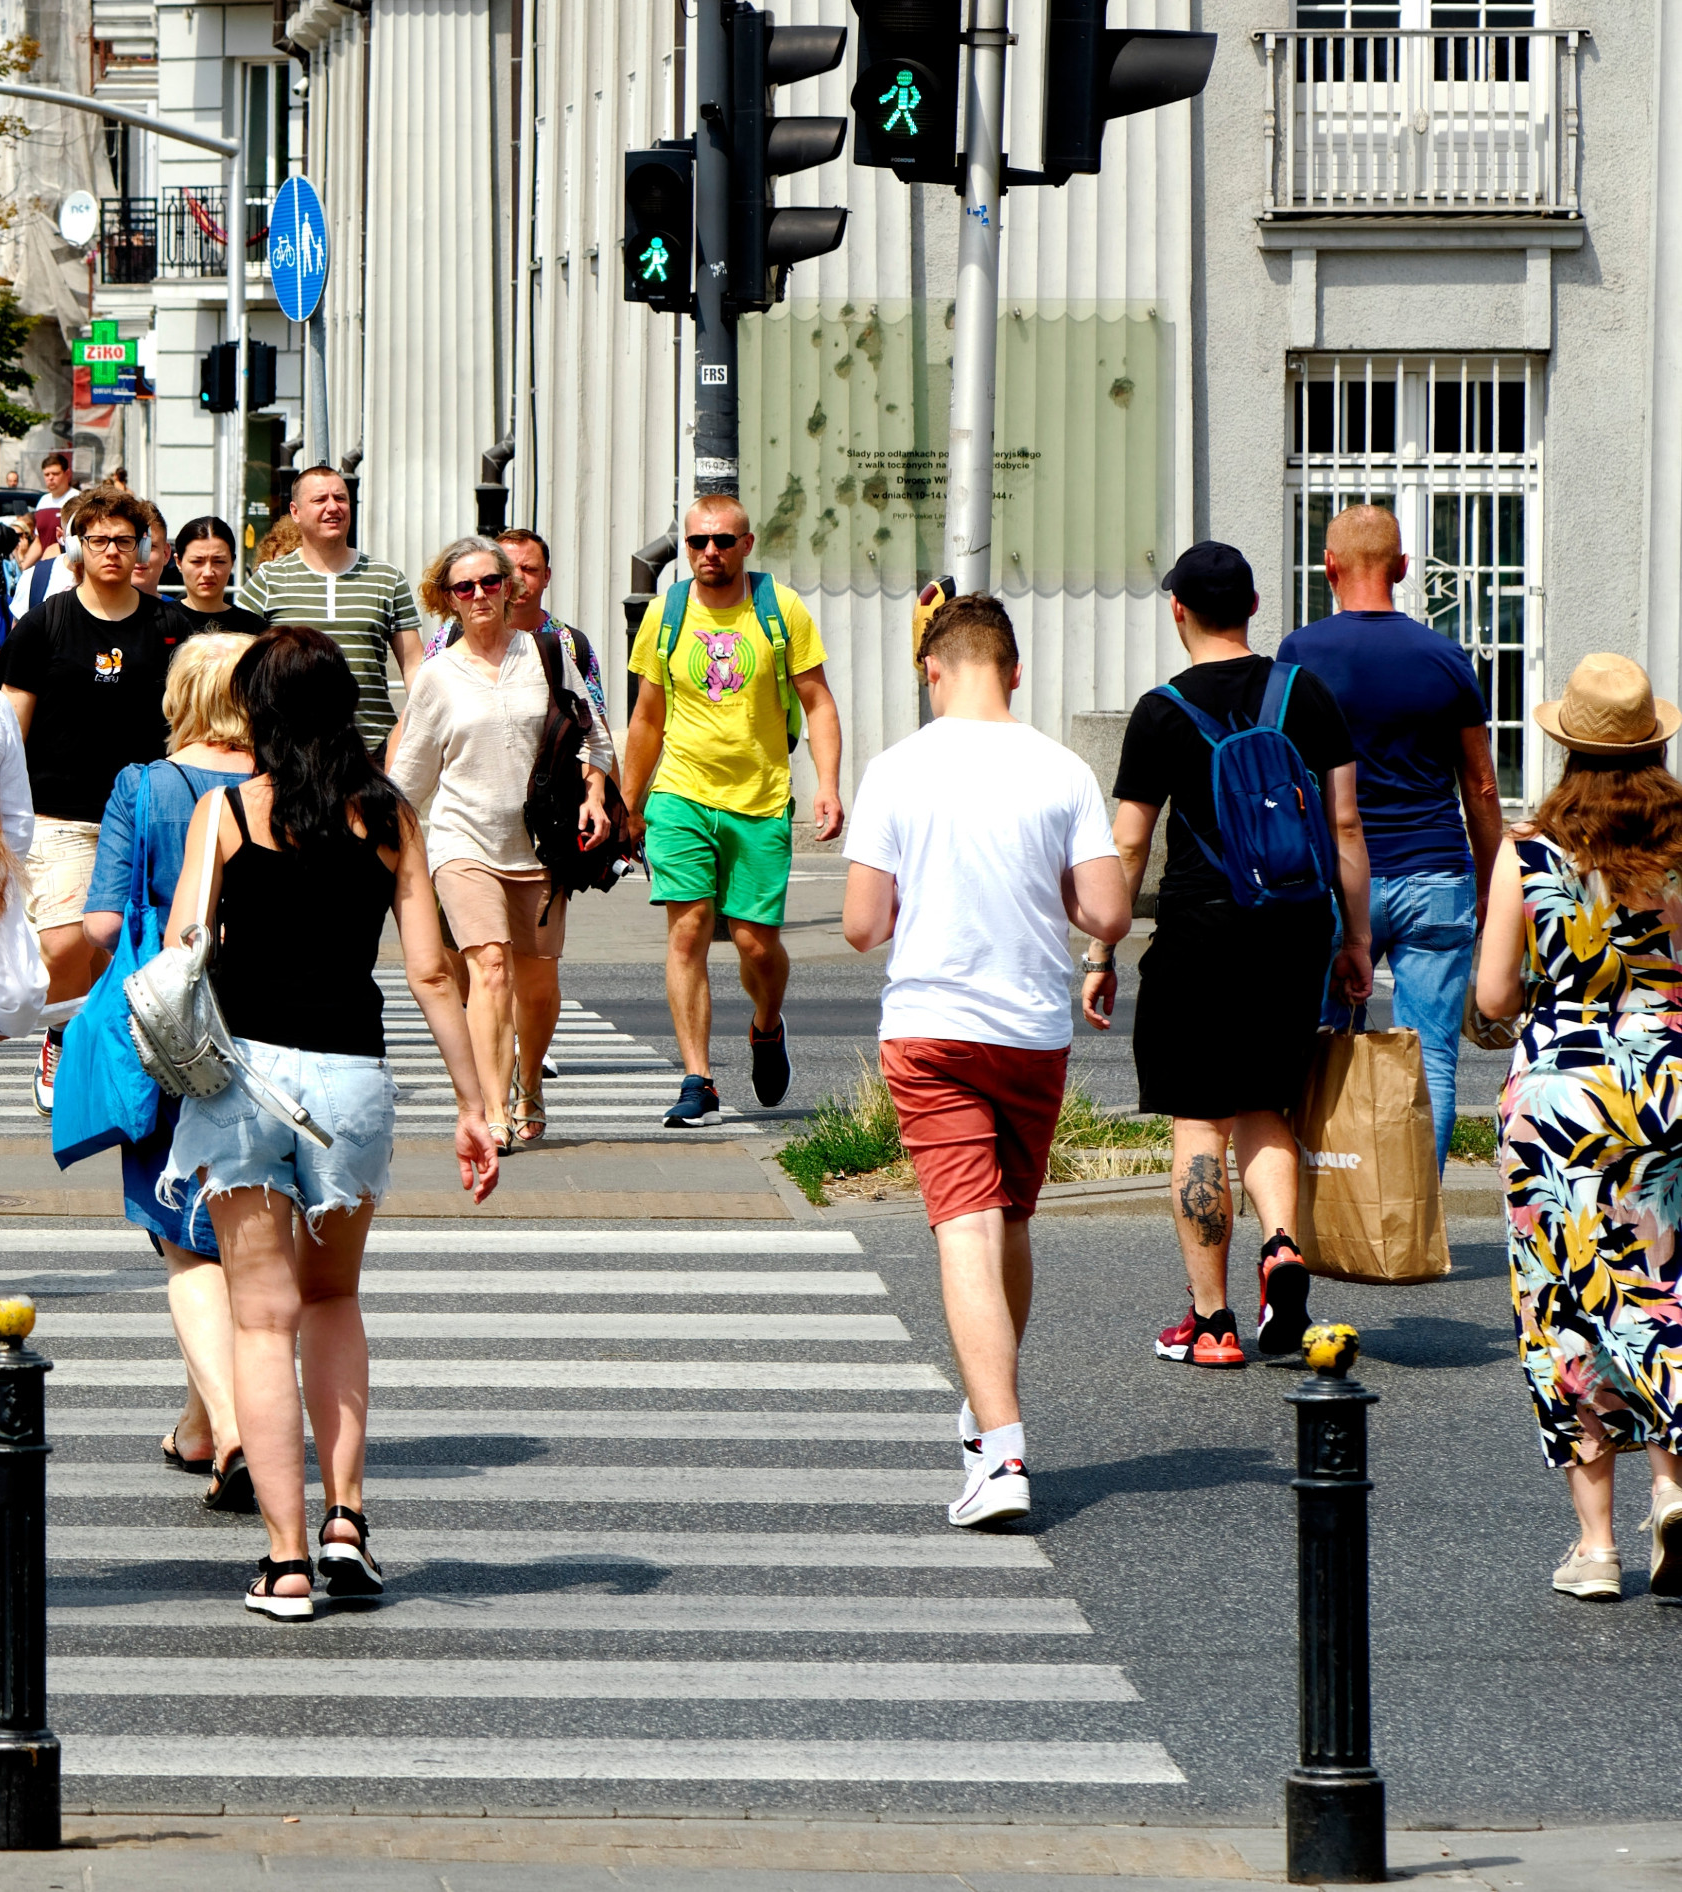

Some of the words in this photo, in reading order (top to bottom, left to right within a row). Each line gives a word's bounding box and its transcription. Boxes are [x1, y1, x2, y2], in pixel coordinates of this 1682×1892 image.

[703, 367, 725, 382] FRS
[846, 448, 872, 460] Ślady
[873, 450, 886, 460] po
[865, 461, 885, 469] walk
[887, 461, 933, 470] toczonych
[896, 476, 932, 485] Dworca
[881, 491, 912, 500] dniach
